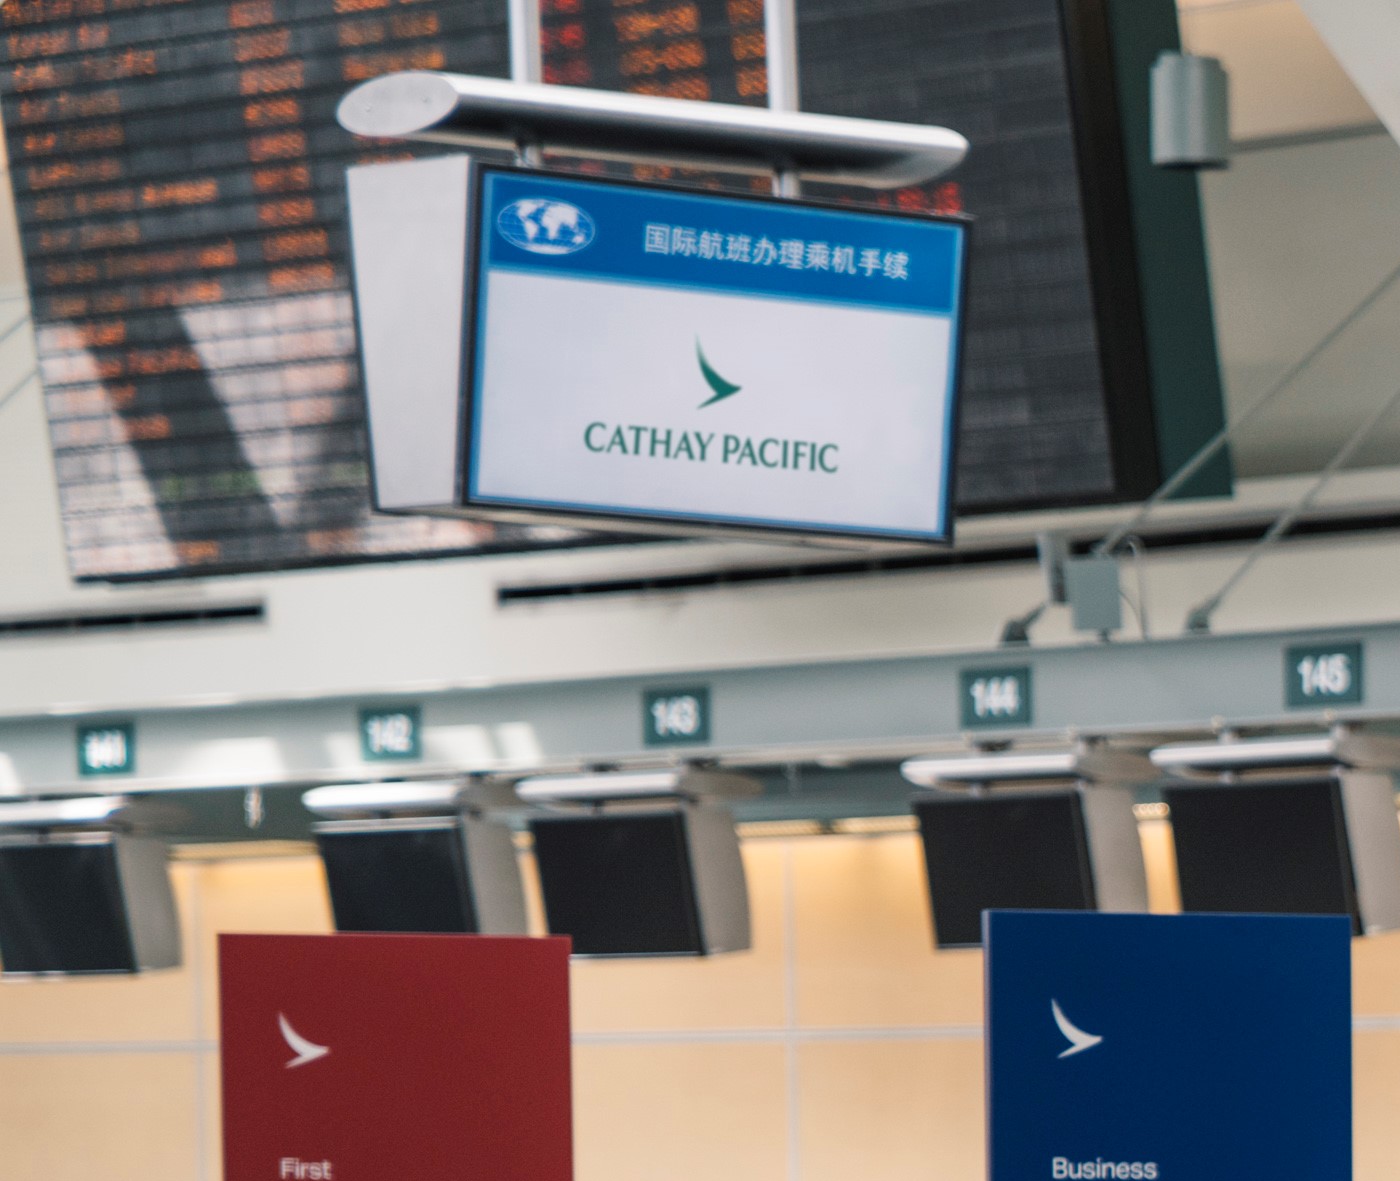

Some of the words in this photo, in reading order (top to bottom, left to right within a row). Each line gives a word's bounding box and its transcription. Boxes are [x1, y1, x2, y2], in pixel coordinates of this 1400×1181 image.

[644, 223, 909, 281] 国际航班办理乘机手续
[584, 421, 715, 463] CATHAY
[722, 434, 839, 474] PACIFIC
[1297, 654, 1351, 696] 145
[651, 697, 700, 736] 143
[970, 677, 1020, 717] 144
[367, 714, 413, 753] 142
[280, 1157, 332, 1180] First
[1052, 1156, 1158, 1180] Business
